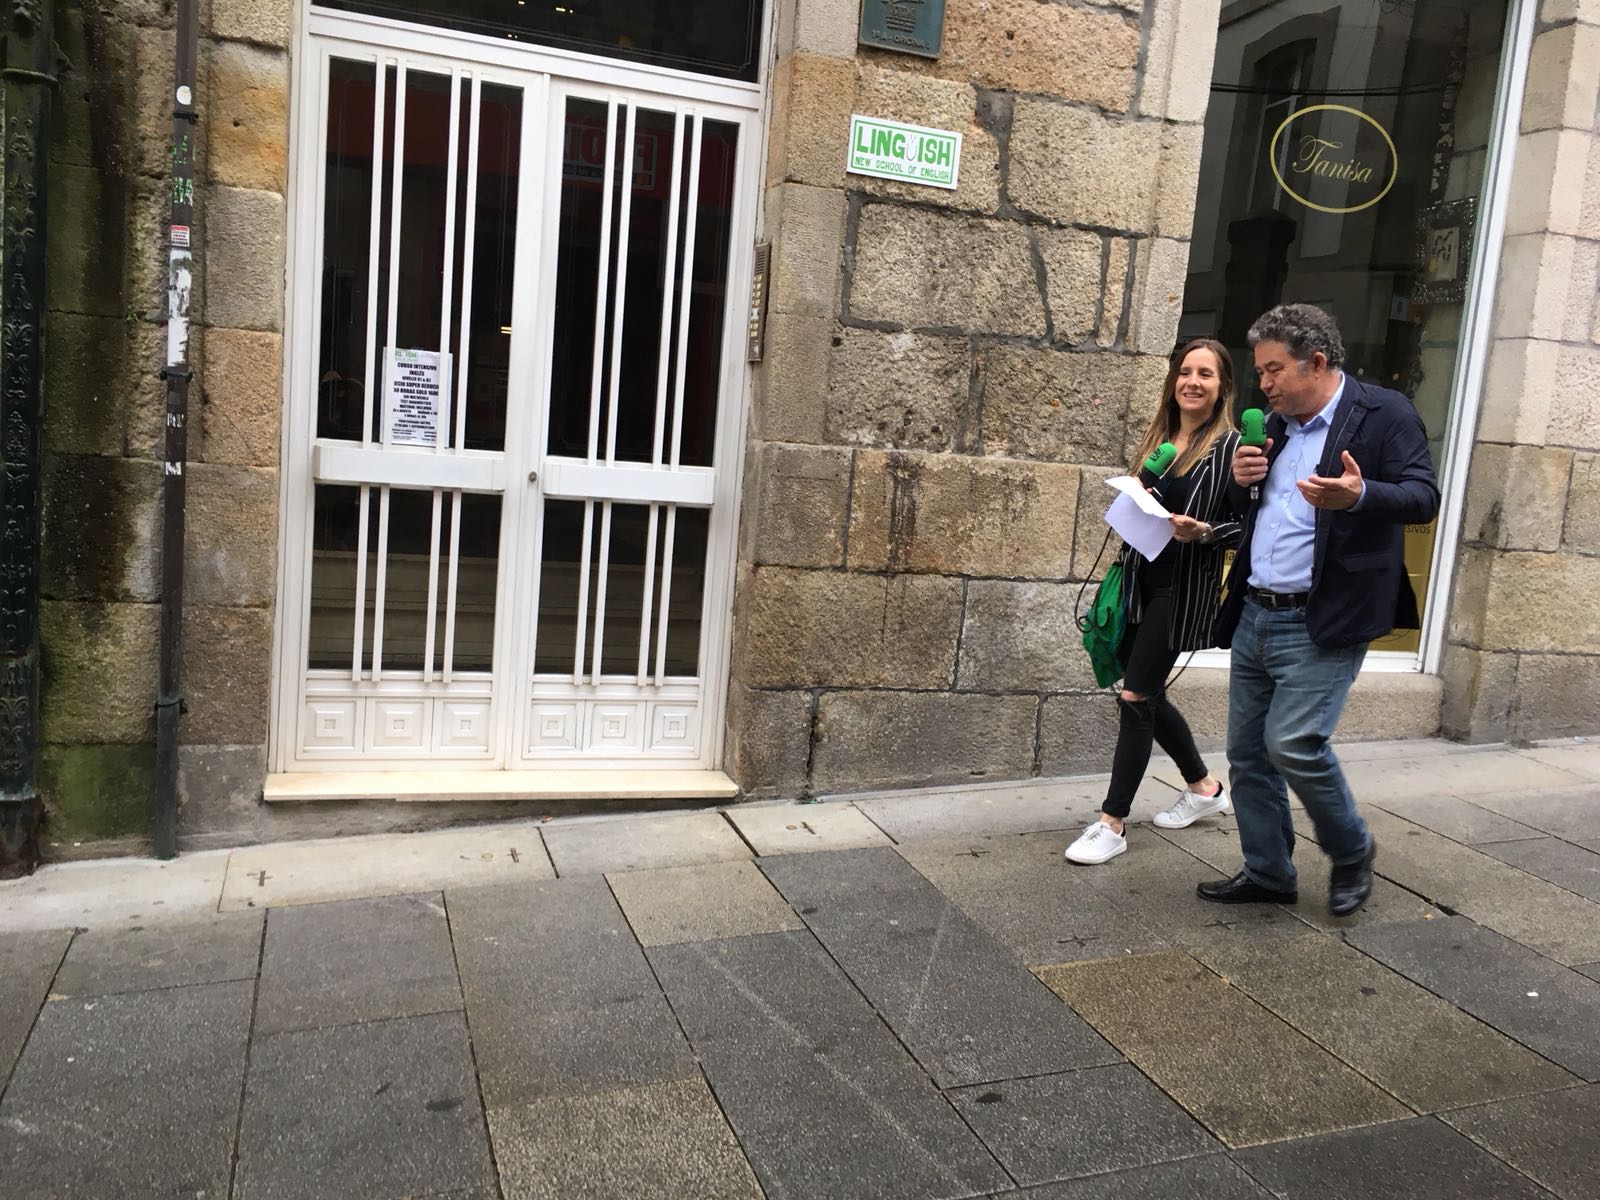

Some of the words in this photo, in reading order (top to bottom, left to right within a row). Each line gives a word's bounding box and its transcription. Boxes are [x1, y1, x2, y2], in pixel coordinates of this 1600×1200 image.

[855, 156, 871, 167] NEW
[875, 160, 904, 173] SCHOOL
[907, 165, 917, 174] OF
[920, 167, 950, 180] ENGLISH
[1292, 135, 1373, 184] Tanisa
[413, 363, 437, 371] INTENSIVO
